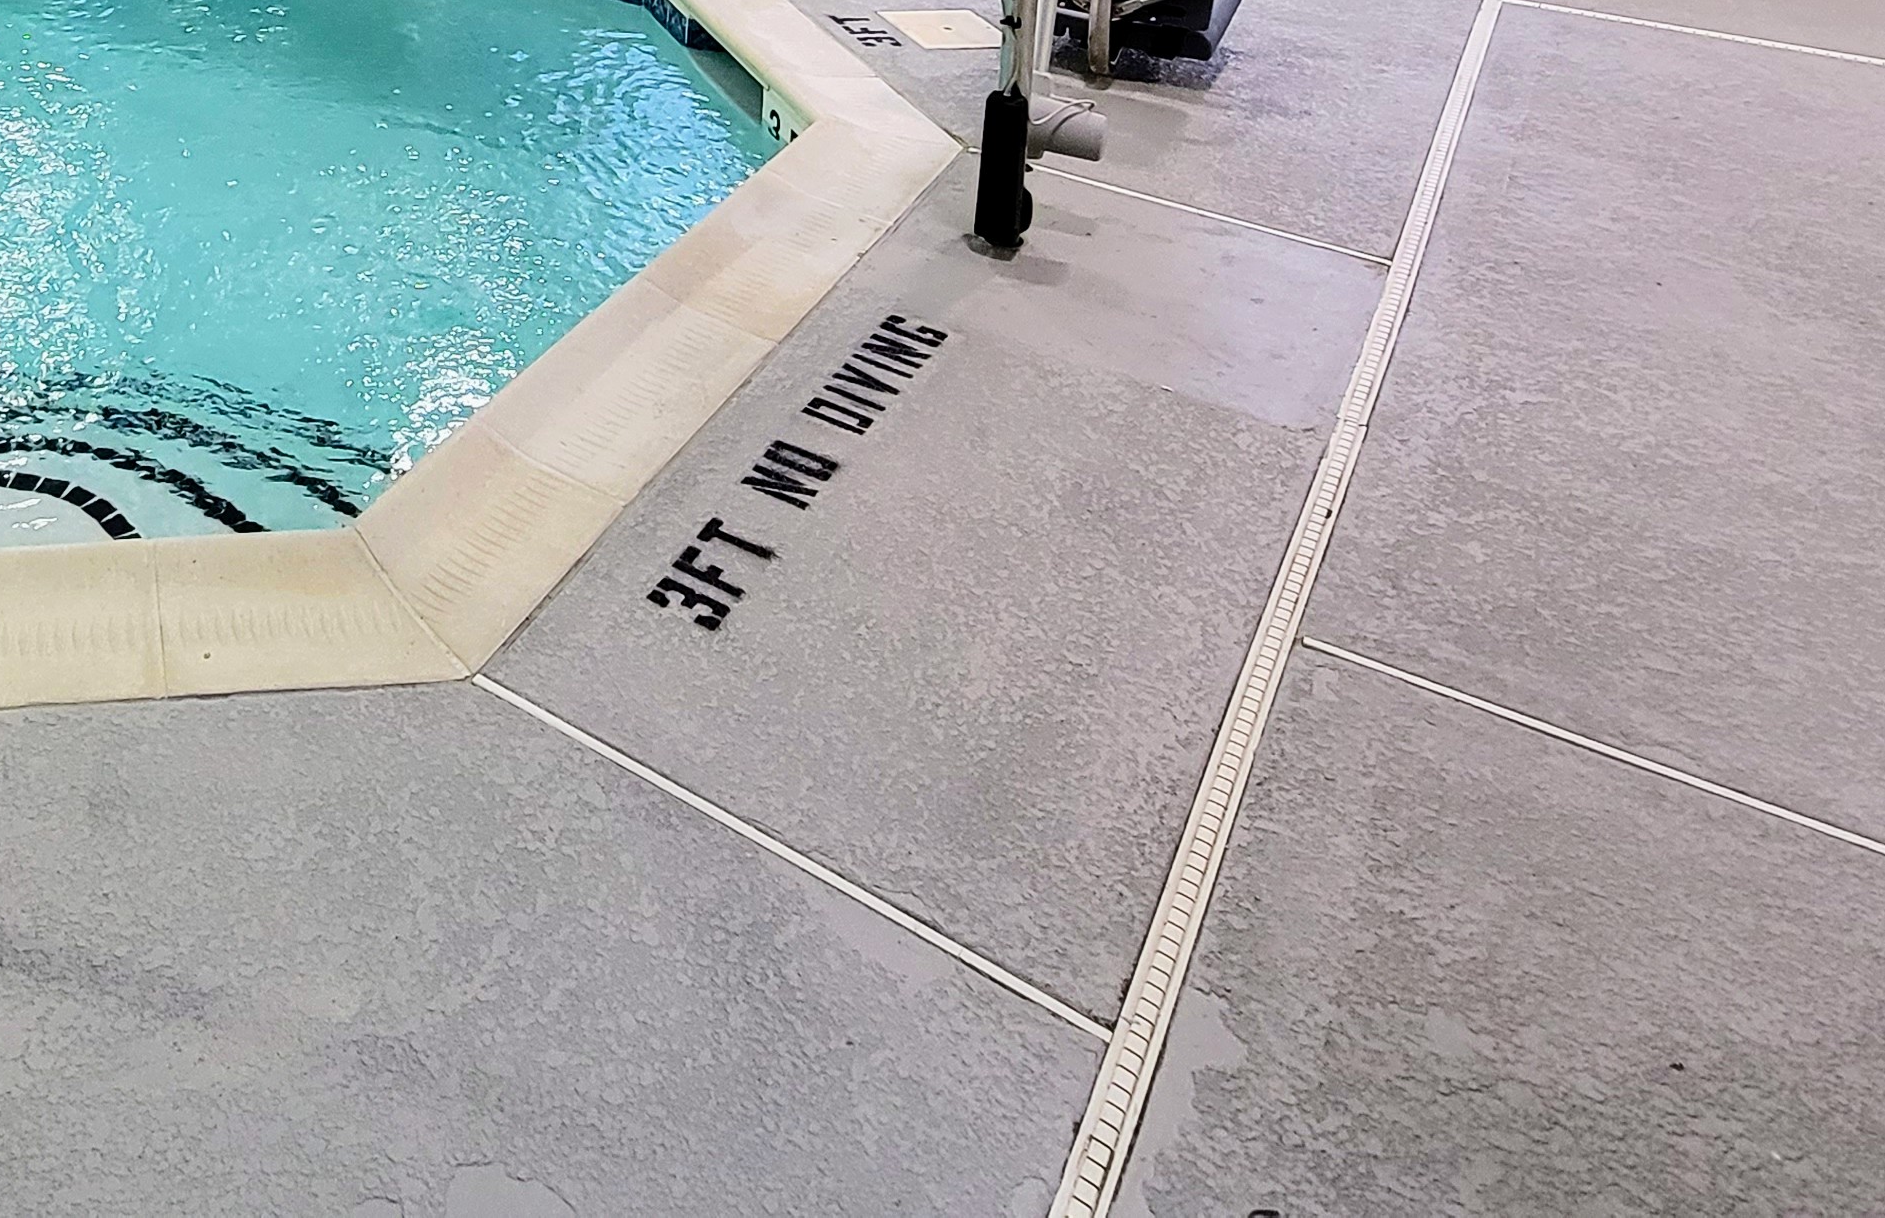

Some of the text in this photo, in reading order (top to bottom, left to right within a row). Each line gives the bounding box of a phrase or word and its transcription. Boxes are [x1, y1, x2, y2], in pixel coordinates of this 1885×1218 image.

[826, 13, 903, 48] 3FT
[767, 109, 781, 140] 3
[645, 314, 950, 632] 3FT NO DIVING
